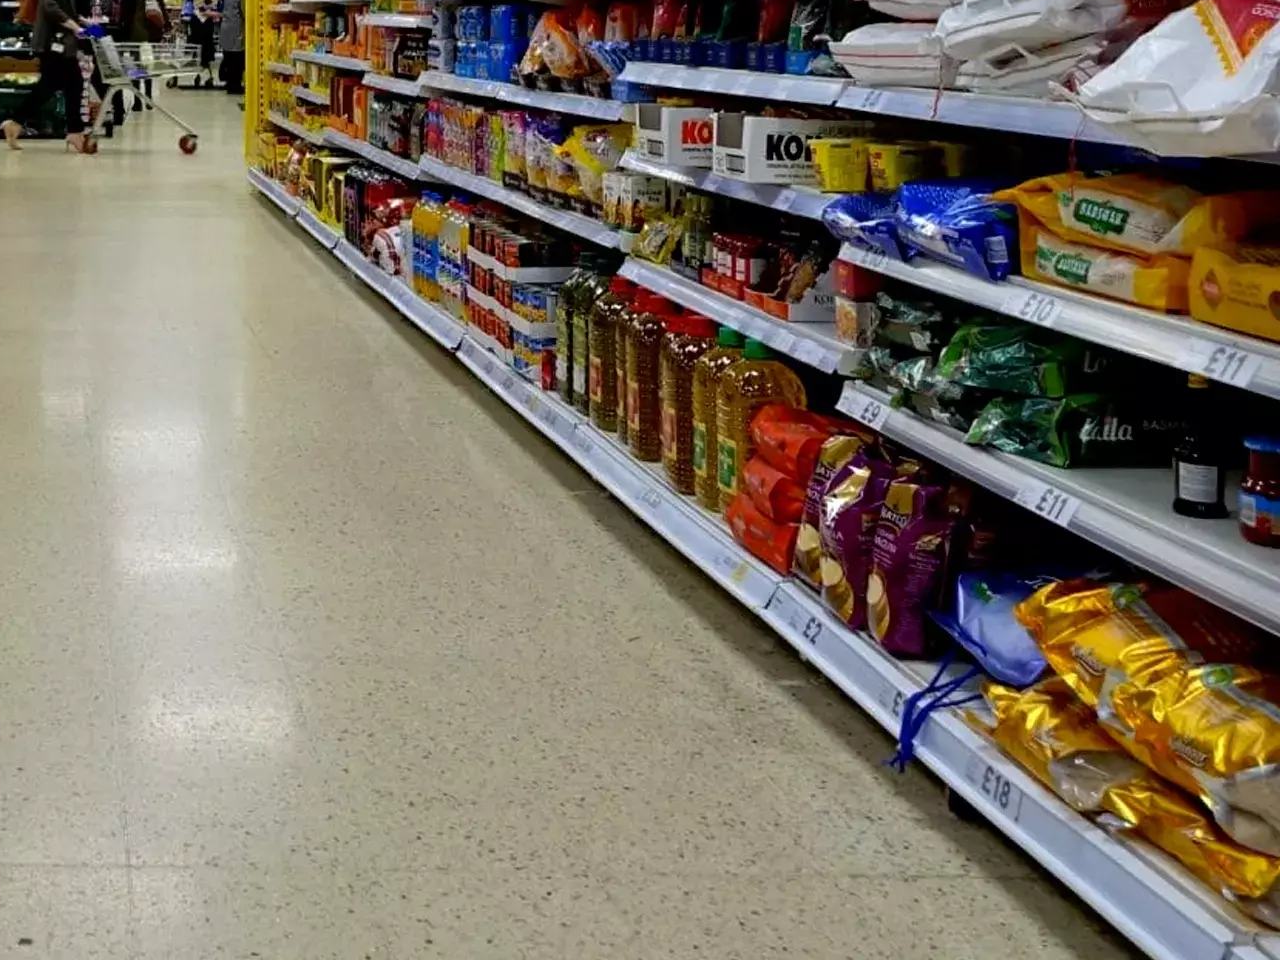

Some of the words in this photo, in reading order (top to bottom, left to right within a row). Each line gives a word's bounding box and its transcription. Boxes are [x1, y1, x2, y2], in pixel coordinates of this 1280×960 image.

[1020, 293, 1055, 322] £10
[1203, 347, 1248, 381] £11
[860, 401, 882, 424] £9
[1035, 488, 1068, 521] £11
[803, 617, 822, 645] £2
[982, 765, 1011, 810] £18
